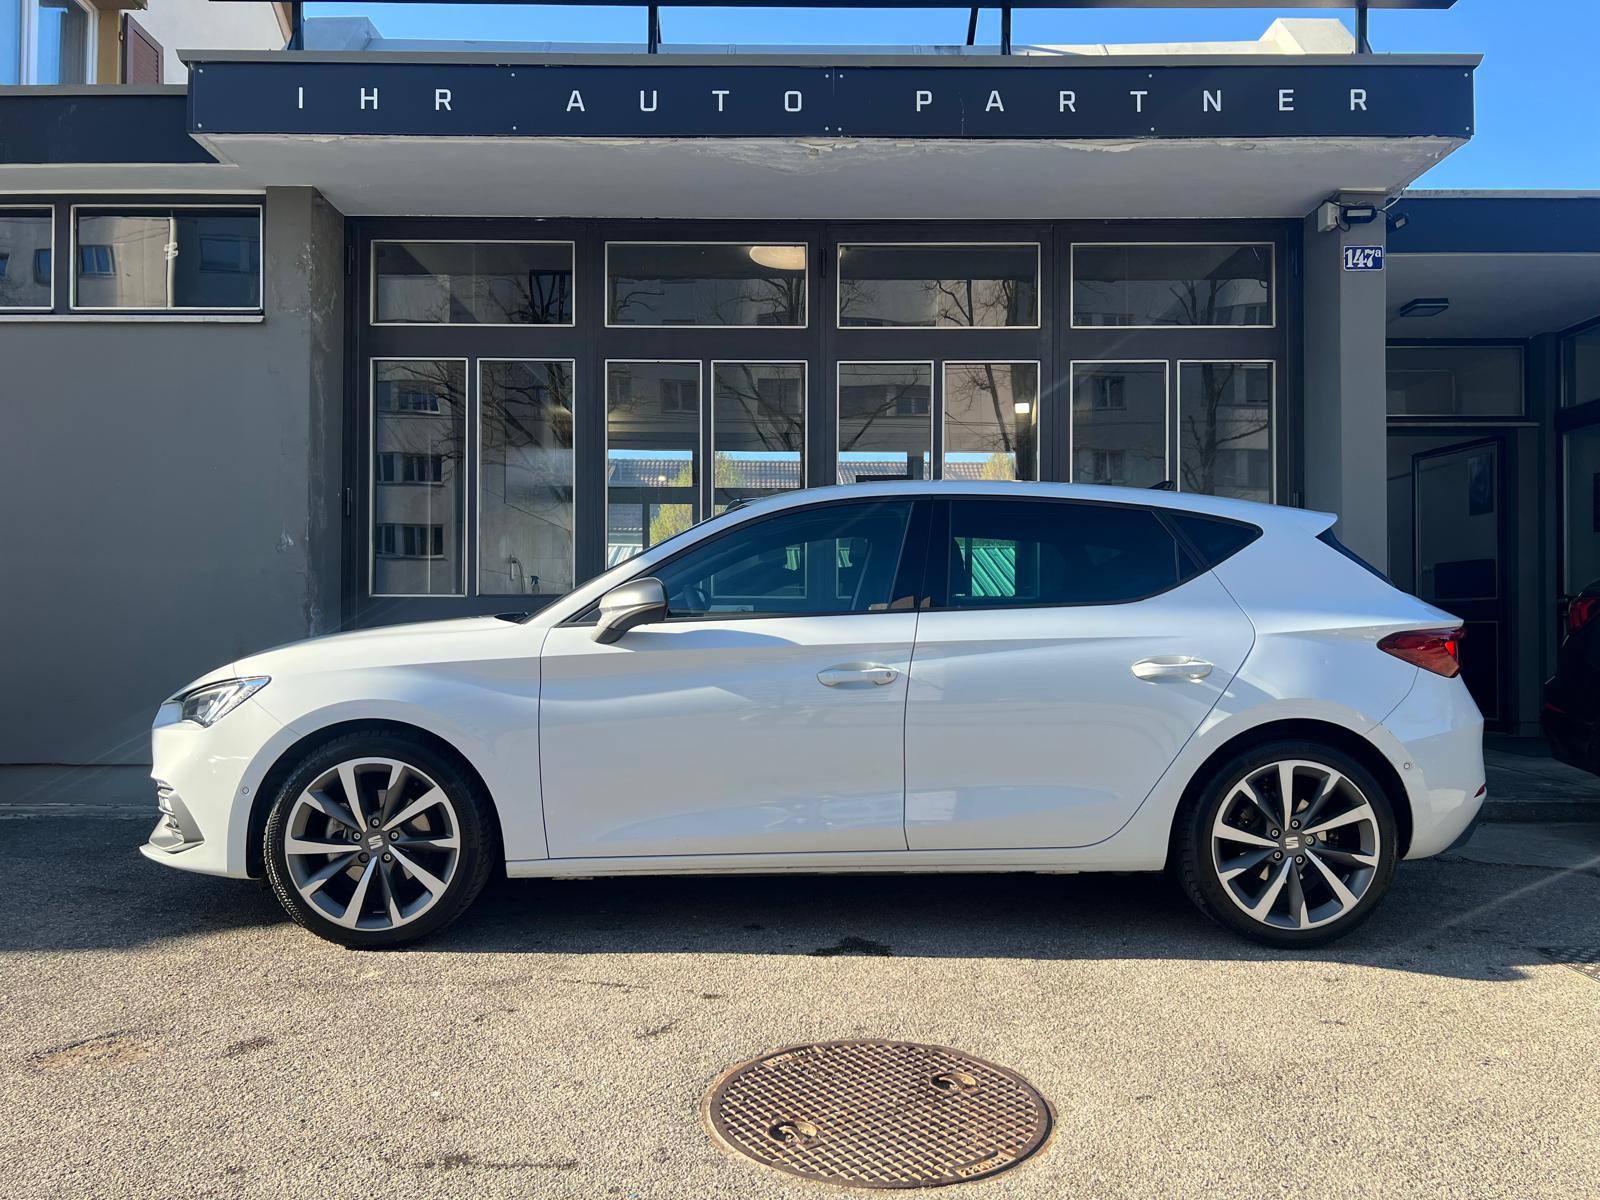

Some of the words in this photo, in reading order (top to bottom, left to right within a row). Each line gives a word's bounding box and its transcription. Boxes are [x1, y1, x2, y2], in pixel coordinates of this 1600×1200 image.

[298, 86, 452, 111] IHR
[566, 89, 802, 112] AUTO
[916, 88, 1367, 113] PARTNER
[1345, 249, 1382, 267] 147a
